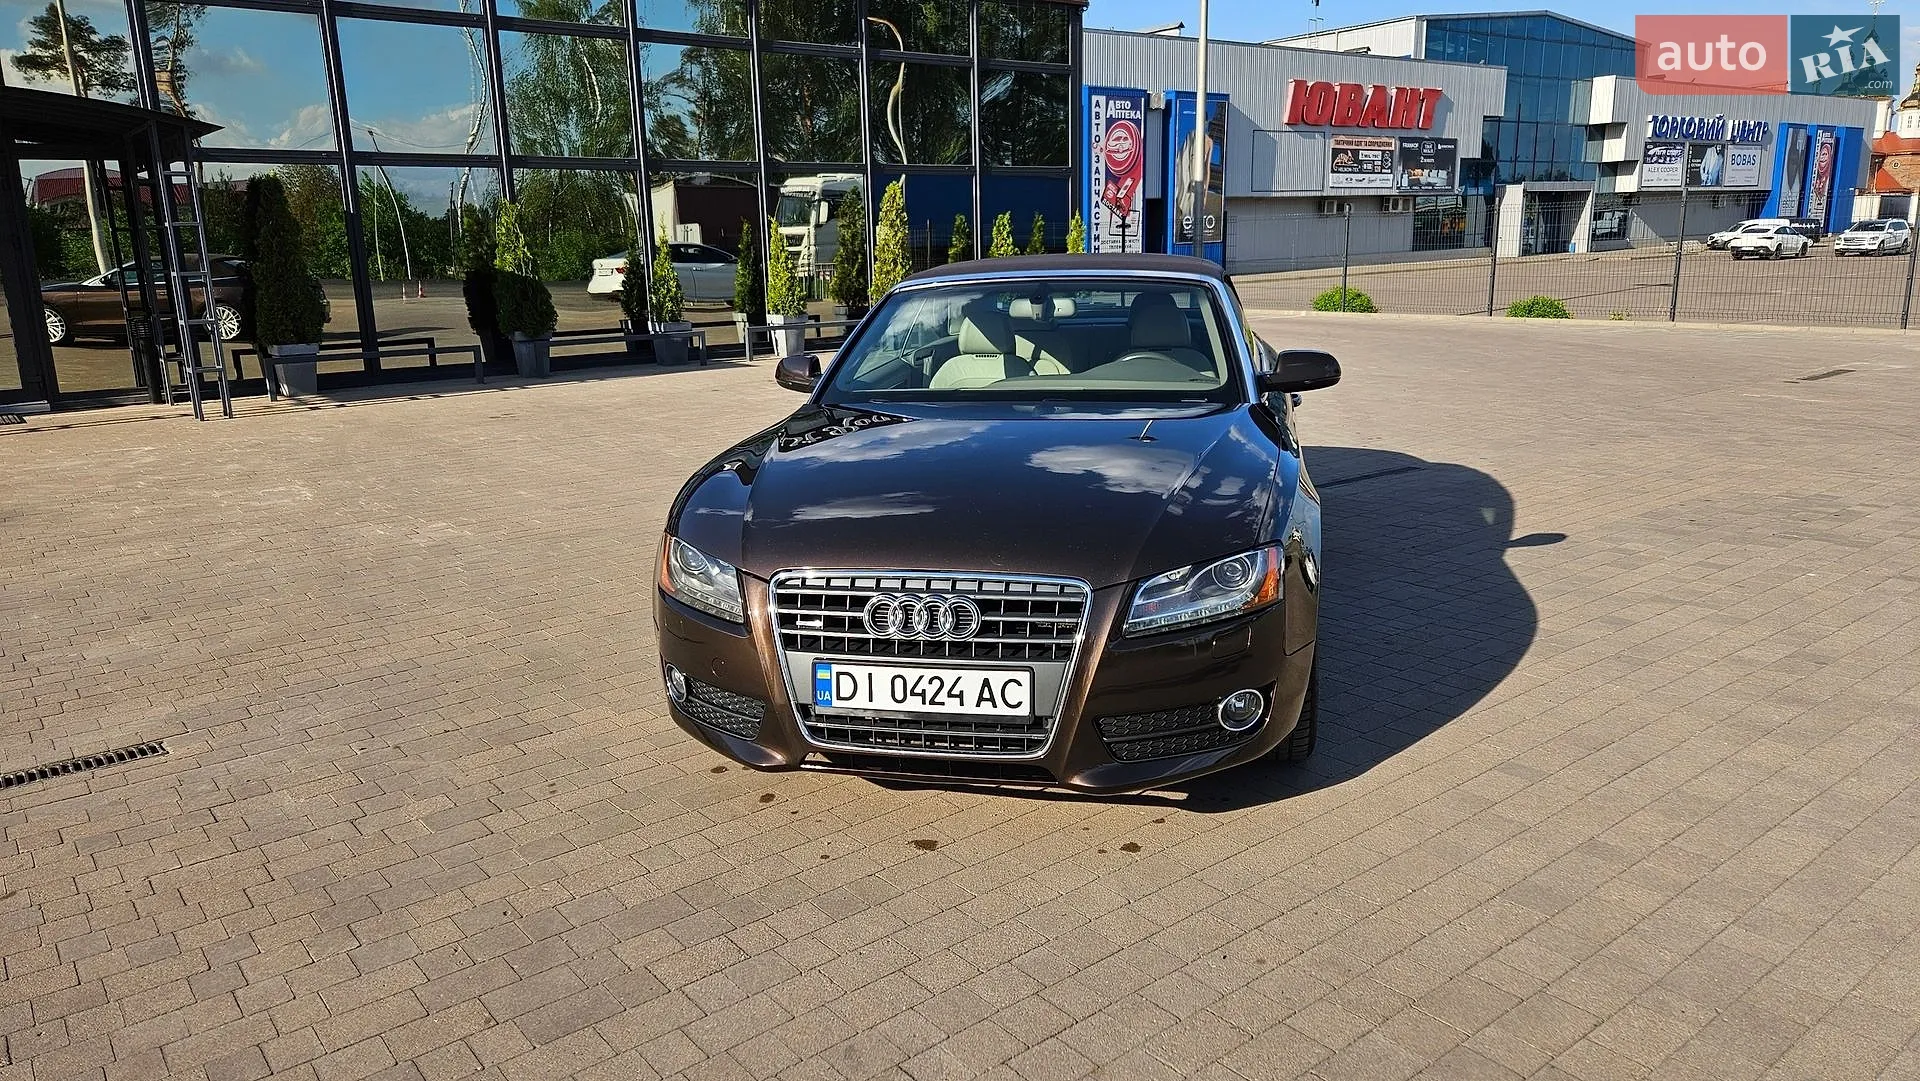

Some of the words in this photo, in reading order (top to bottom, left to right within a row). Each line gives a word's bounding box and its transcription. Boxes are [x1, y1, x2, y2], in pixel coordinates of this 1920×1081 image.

[1285, 79, 1443, 131] ЮВАНТ
[1647, 114, 1726, 141] ТОРГОВИЙ
[1731, 153, 1757, 166] BOBAS
[817, 690, 832, 701] UA
[835, 670, 874, 703] DI
[890, 673, 965, 707] 0424
[975, 677, 1024, 710] AC
